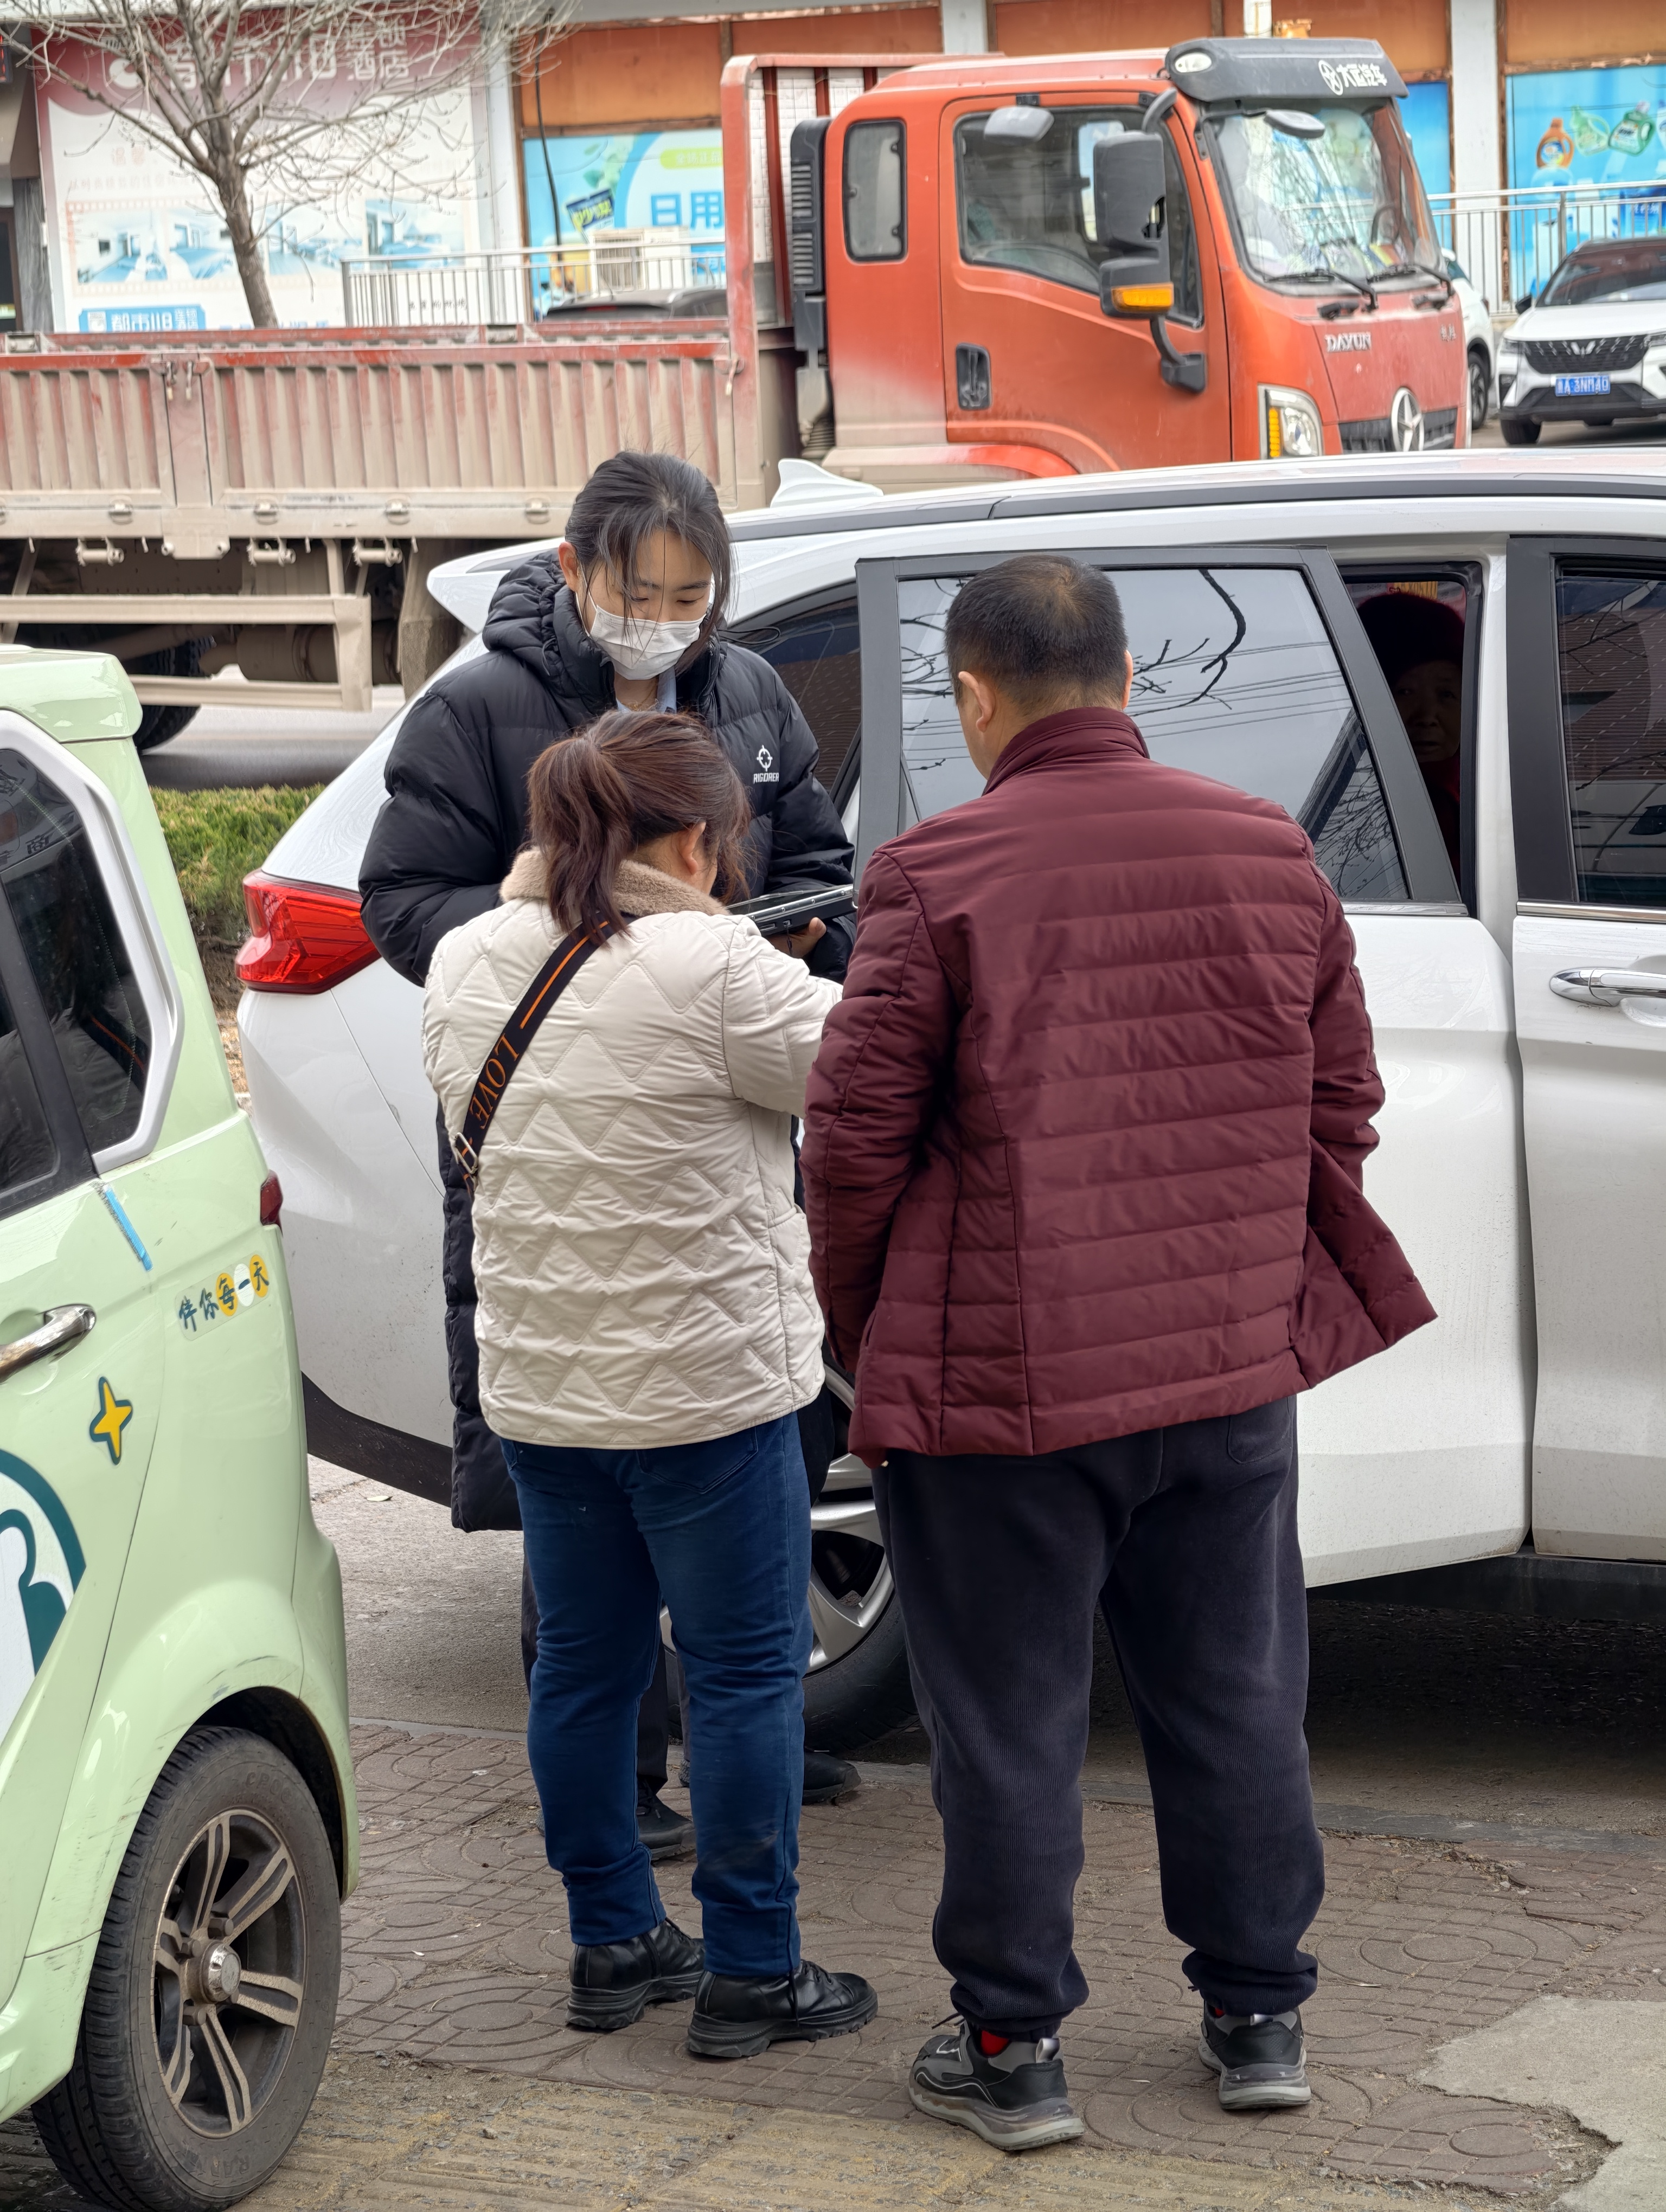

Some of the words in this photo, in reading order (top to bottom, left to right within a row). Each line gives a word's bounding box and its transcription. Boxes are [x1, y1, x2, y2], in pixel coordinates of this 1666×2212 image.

[1336, 62, 1388, 88] 大运汽车
[650, 191, 725, 229] 日用
[1324, 331, 1372, 352] DAYUN
[753, 772, 779, 785] RIGORER
[470, 1033, 520, 1129] LOVE
[179, 1261, 270, 1332] 伴你每一天
